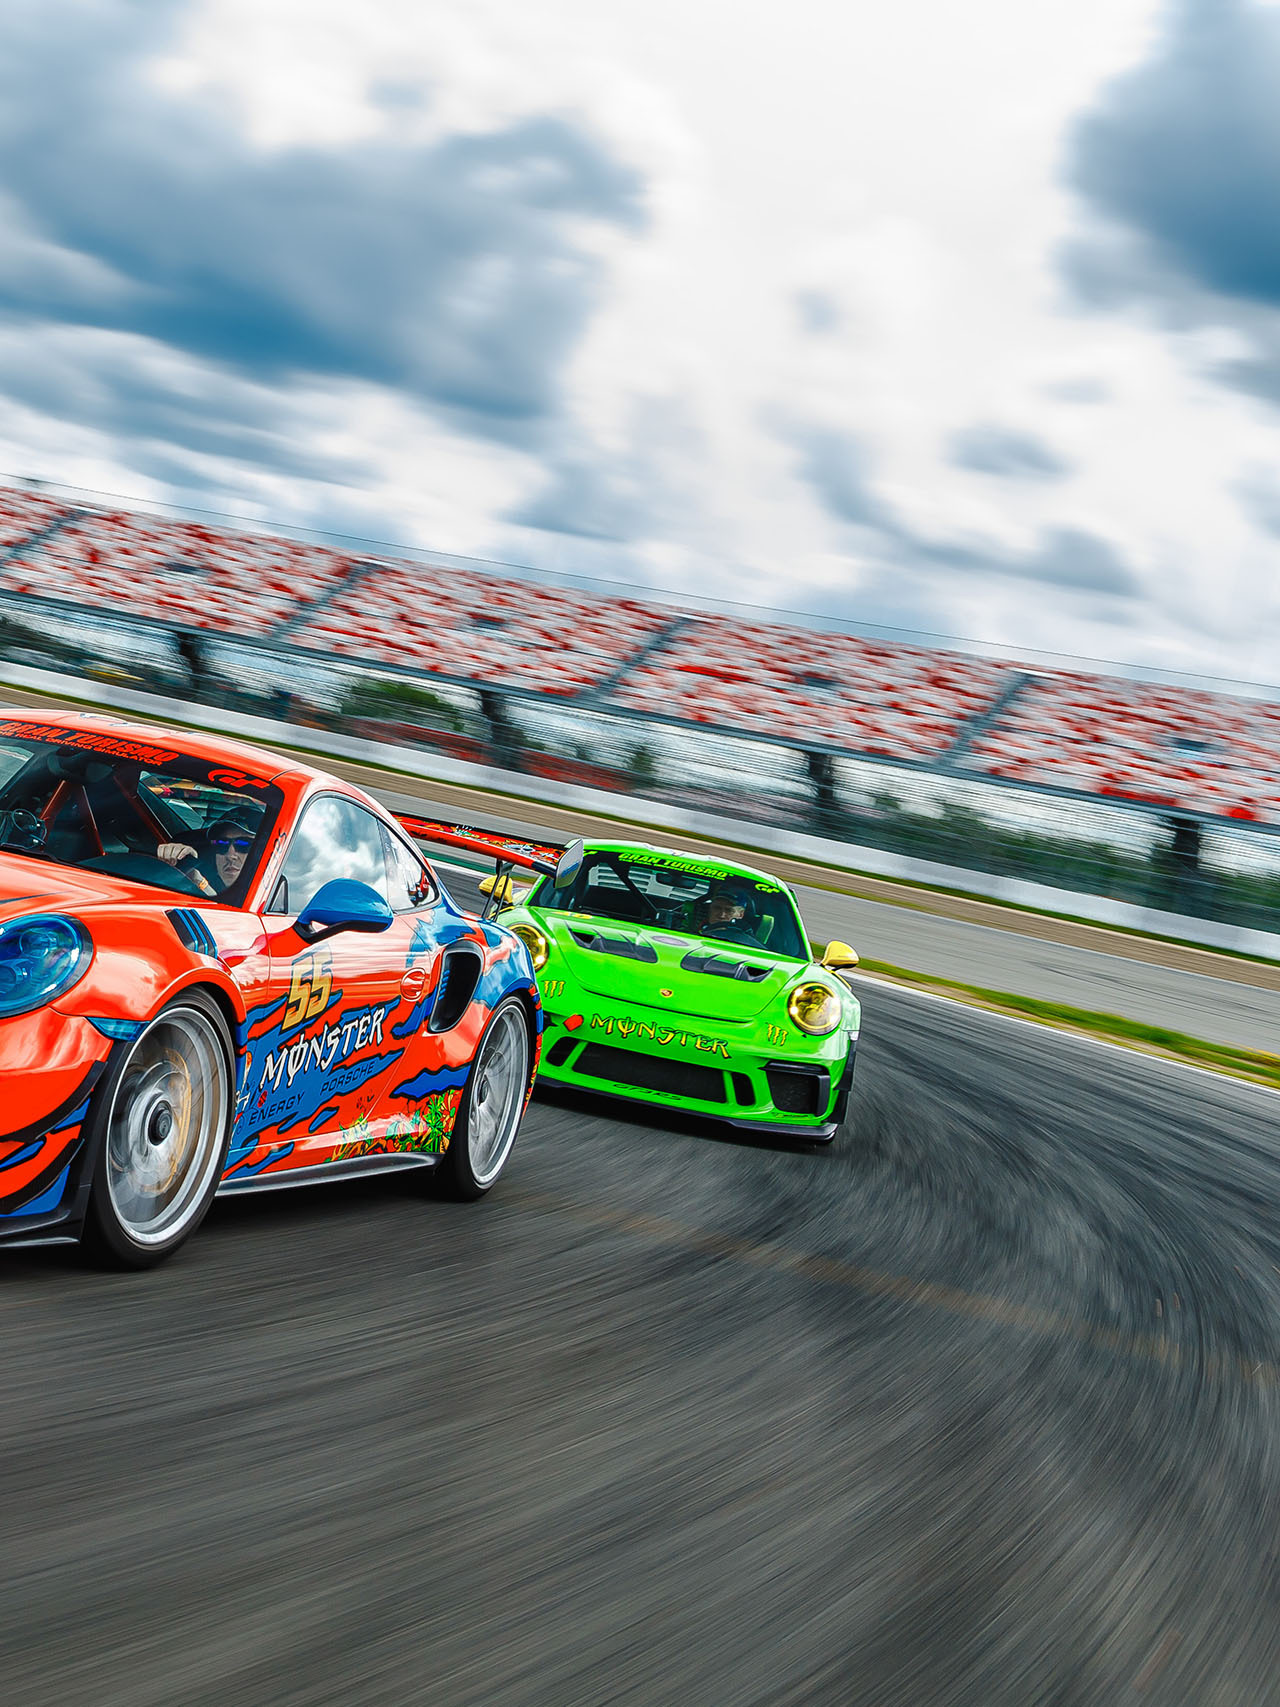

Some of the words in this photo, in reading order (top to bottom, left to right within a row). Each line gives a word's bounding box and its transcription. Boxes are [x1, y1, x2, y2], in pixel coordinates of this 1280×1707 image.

[45, 737, 93, 750] DRIVING
[93, 746, 163, 766] SIMULATOR
[65, 732, 180, 762] TURISMO
[618, 853, 662, 864] GRAN
[664, 859, 730, 878] TURISMO
[281, 943, 334, 1031] 55
[249, 1092, 306, 1126] ENERGY
[320, 1063, 375, 1095] PORSCHE
